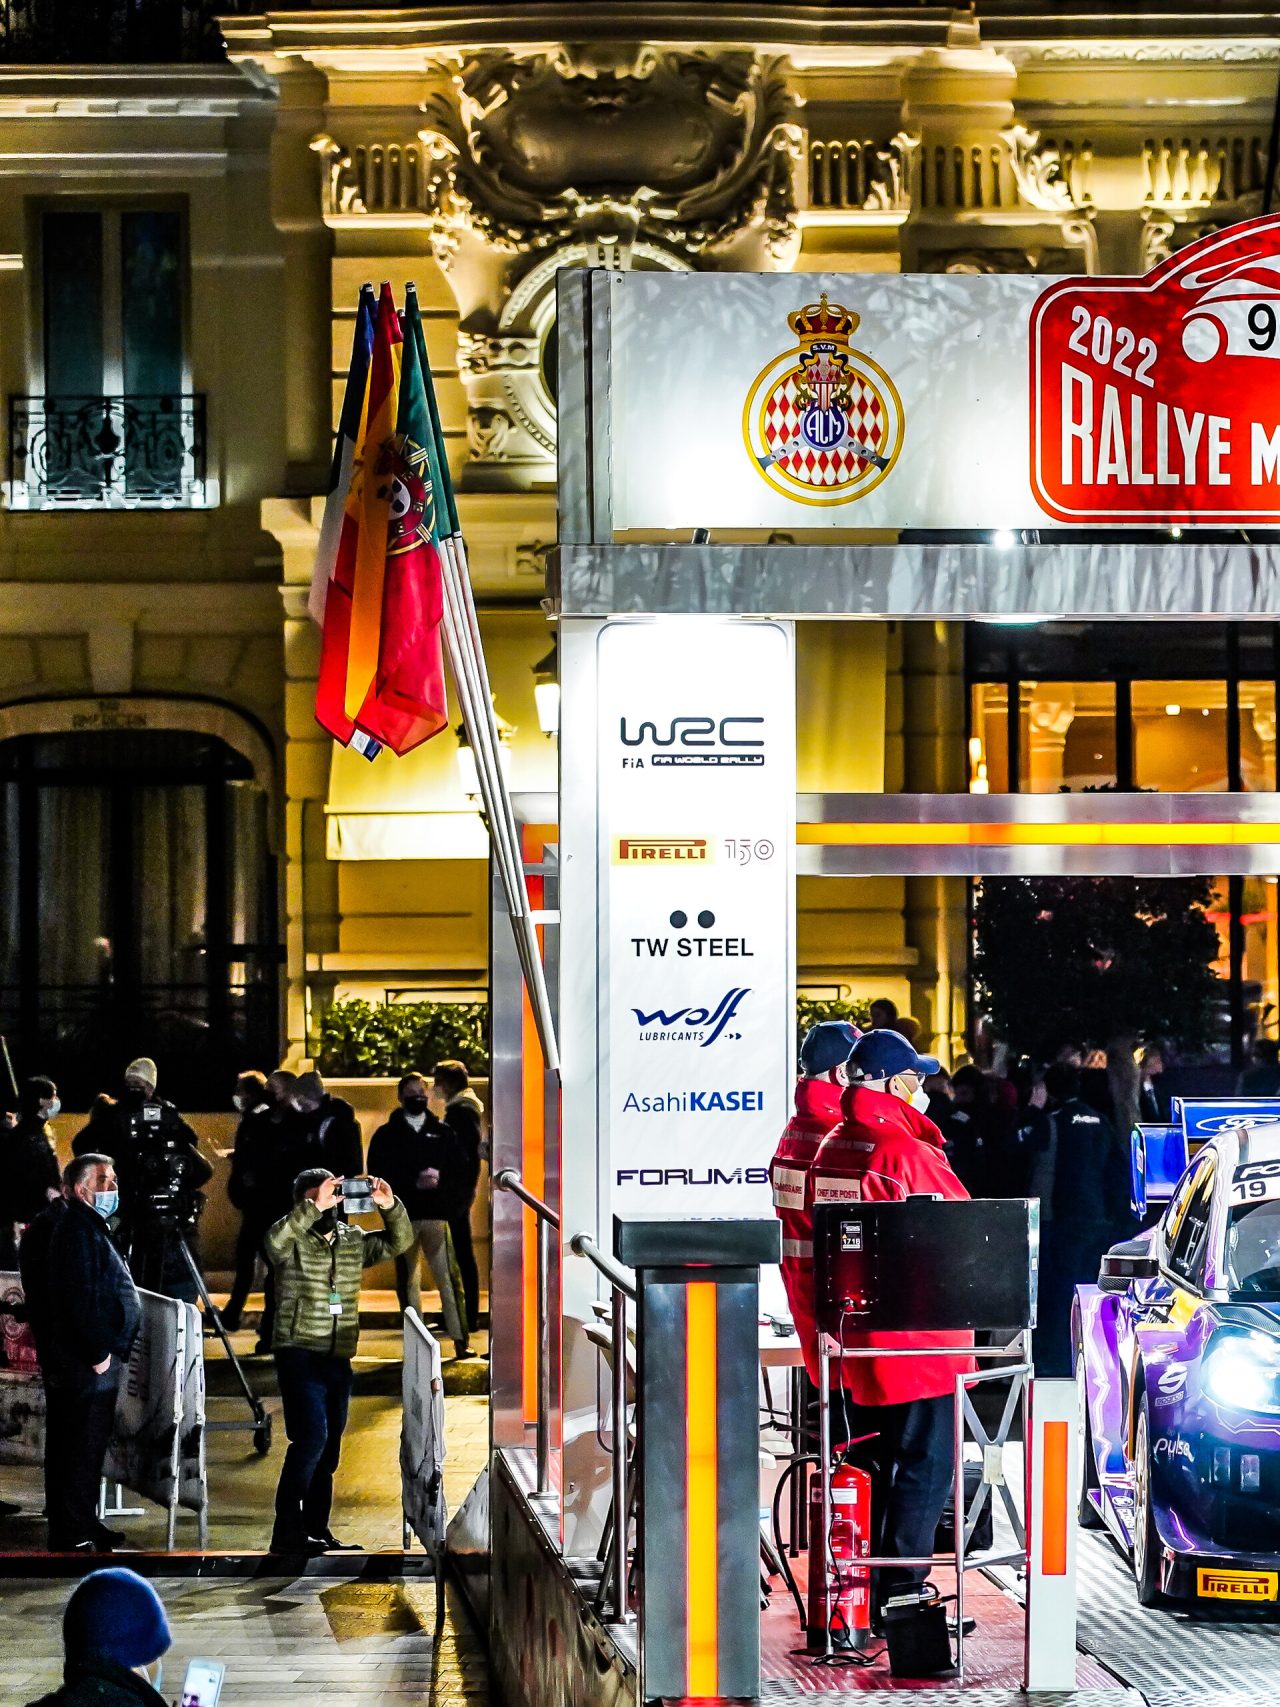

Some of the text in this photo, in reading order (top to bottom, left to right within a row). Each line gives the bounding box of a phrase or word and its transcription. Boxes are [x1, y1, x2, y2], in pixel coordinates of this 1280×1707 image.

[1068, 305, 1158, 388] 2022
[1061, 361, 1231, 485] RALLYE
[620, 717, 764, 746] WRC
[620, 839, 706, 859] PIRELLI
[631, 938, 754, 957] TW STEEL
[640, 1032, 704, 1041] LUBRICANTS
[617, 1168, 768, 1186] FORUM8
[830, 1189, 839, 1198] DE
[840, 1190, 858, 1199] POSTE
[1233, 1181, 1266, 1200] 19
[1203, 1574, 1269, 1594] PIRELLI
